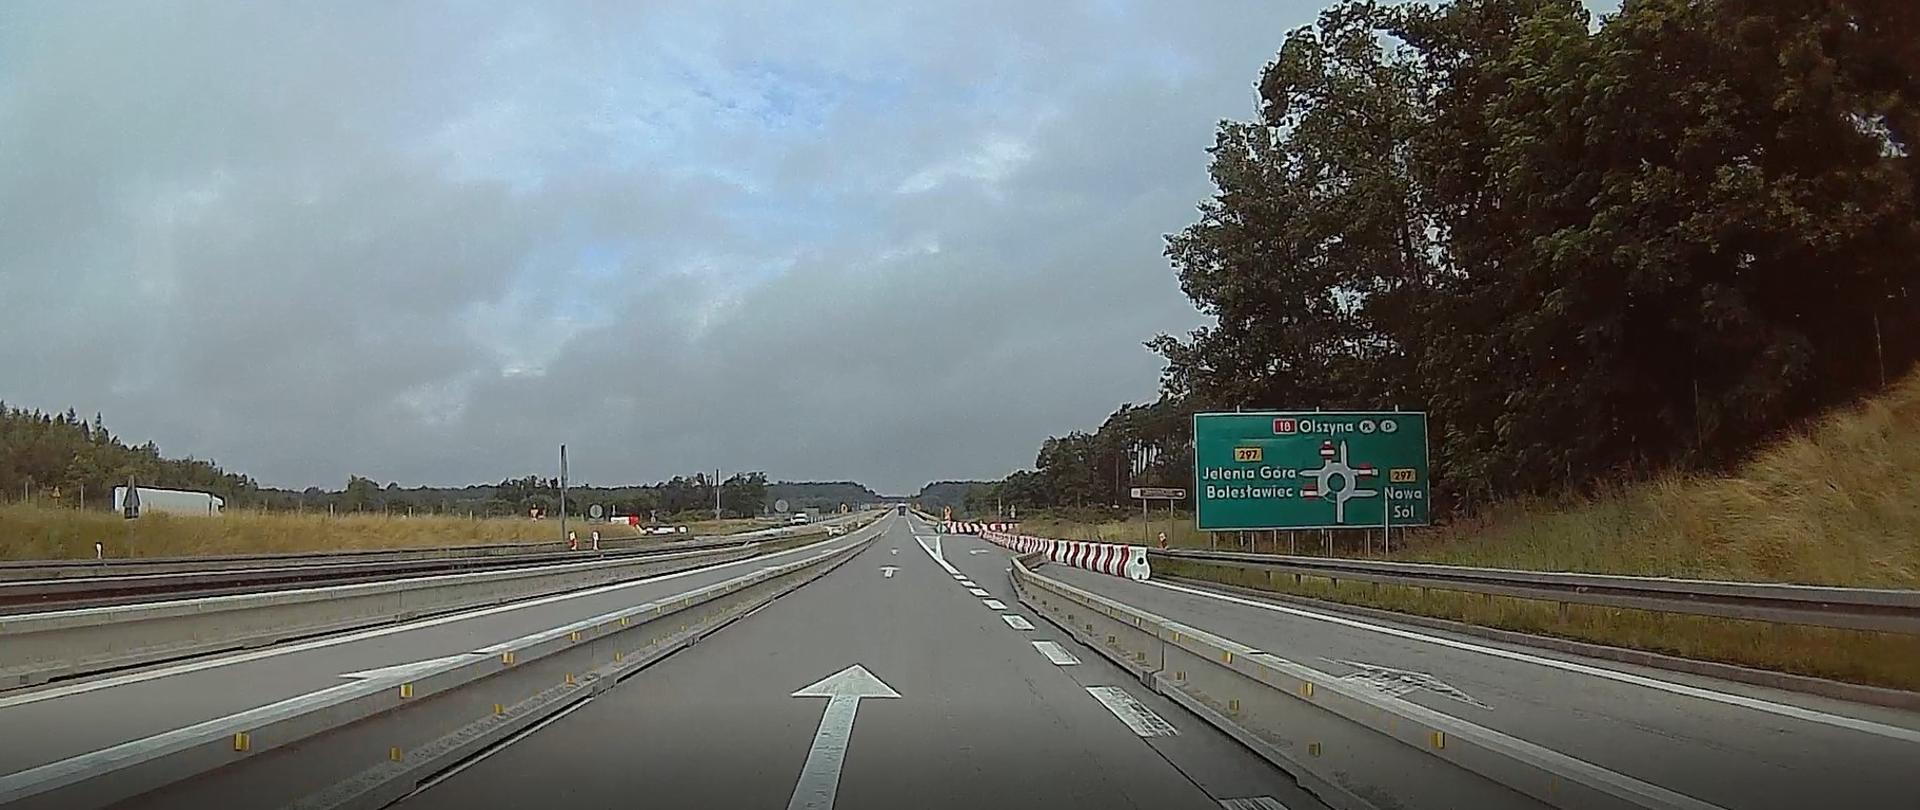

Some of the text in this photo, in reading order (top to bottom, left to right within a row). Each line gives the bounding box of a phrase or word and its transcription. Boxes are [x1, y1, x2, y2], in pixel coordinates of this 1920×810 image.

[1279, 421, 1291, 432] 18
[1300, 420, 1354, 436] Olszyna
[1239, 450, 1258, 459] 297
[1202, 466, 1296, 479] Jelenia Góra
[1394, 471, 1412, 480] 297
[1206, 485, 1293, 498] Bolesławiec
[1385, 487, 1422, 499] Nowa
